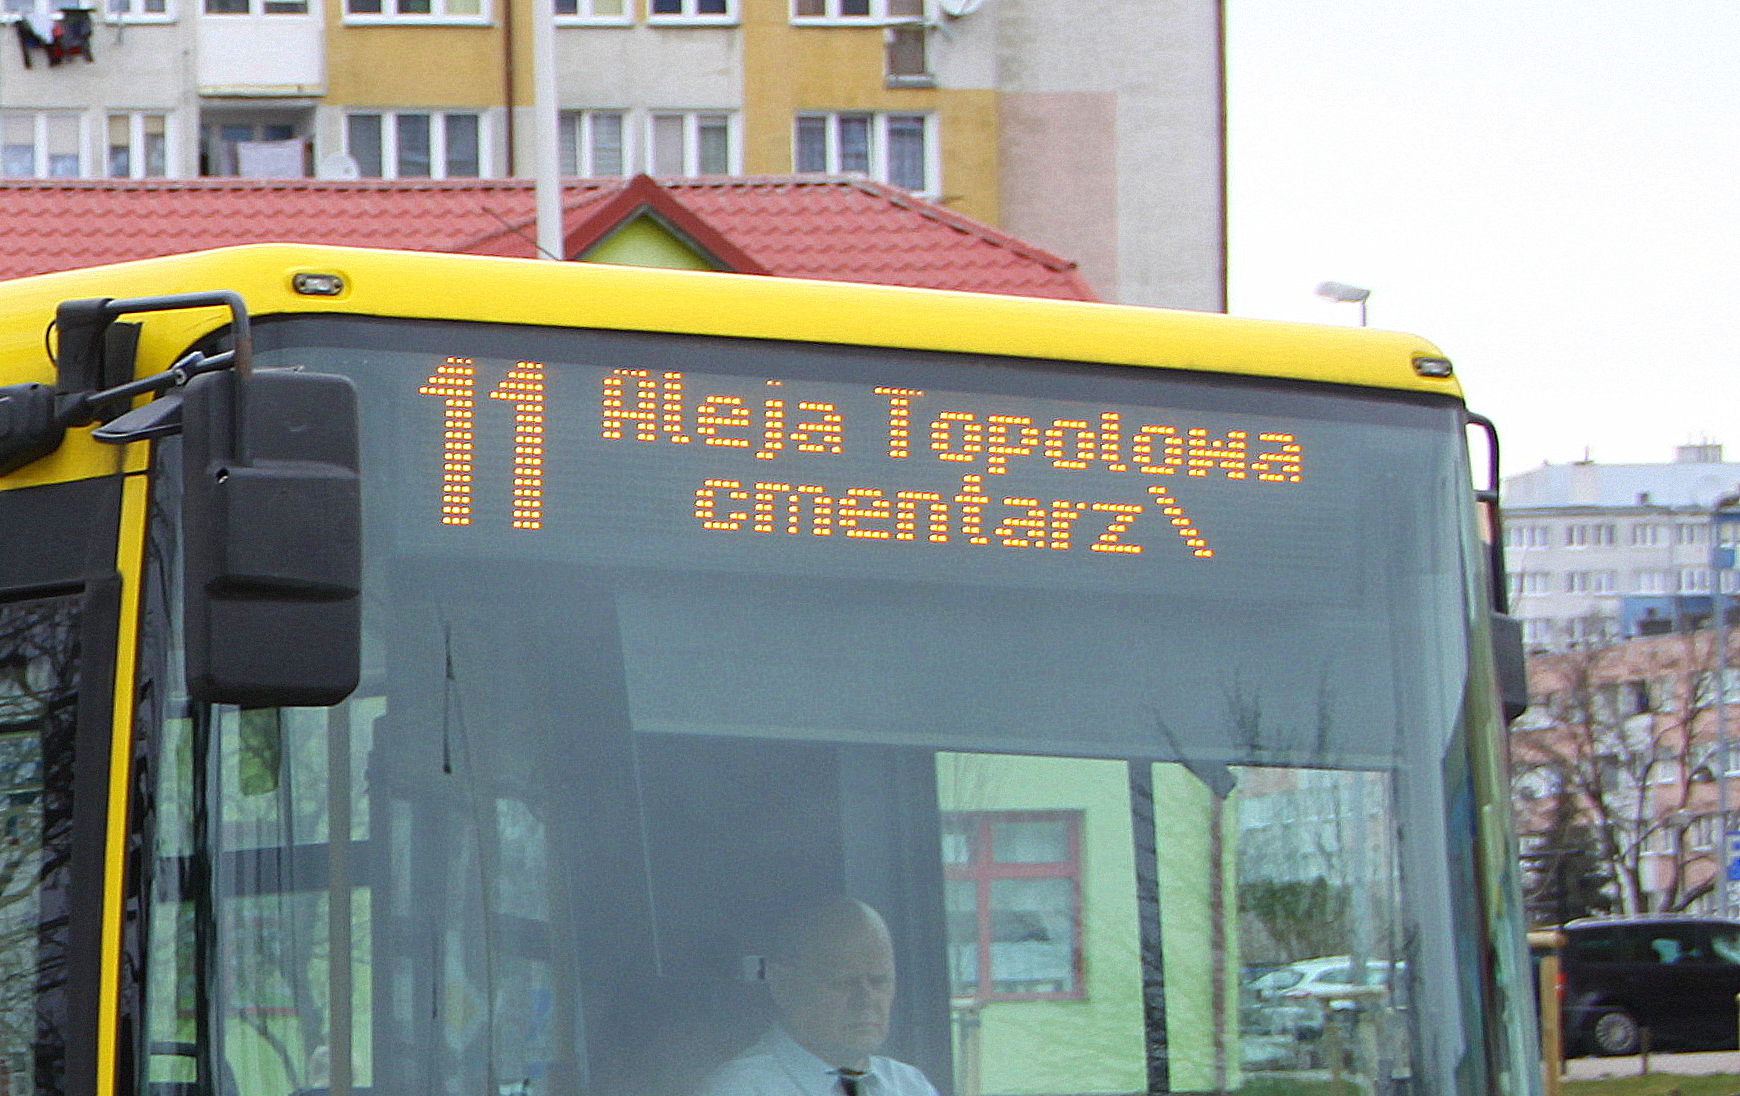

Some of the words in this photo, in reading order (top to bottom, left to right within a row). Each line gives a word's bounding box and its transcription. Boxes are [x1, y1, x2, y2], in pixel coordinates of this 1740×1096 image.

[418, 356, 547, 531] 11
[602, 369, 844, 461] Aleja
[874, 386, 1305, 484] Topolowa
